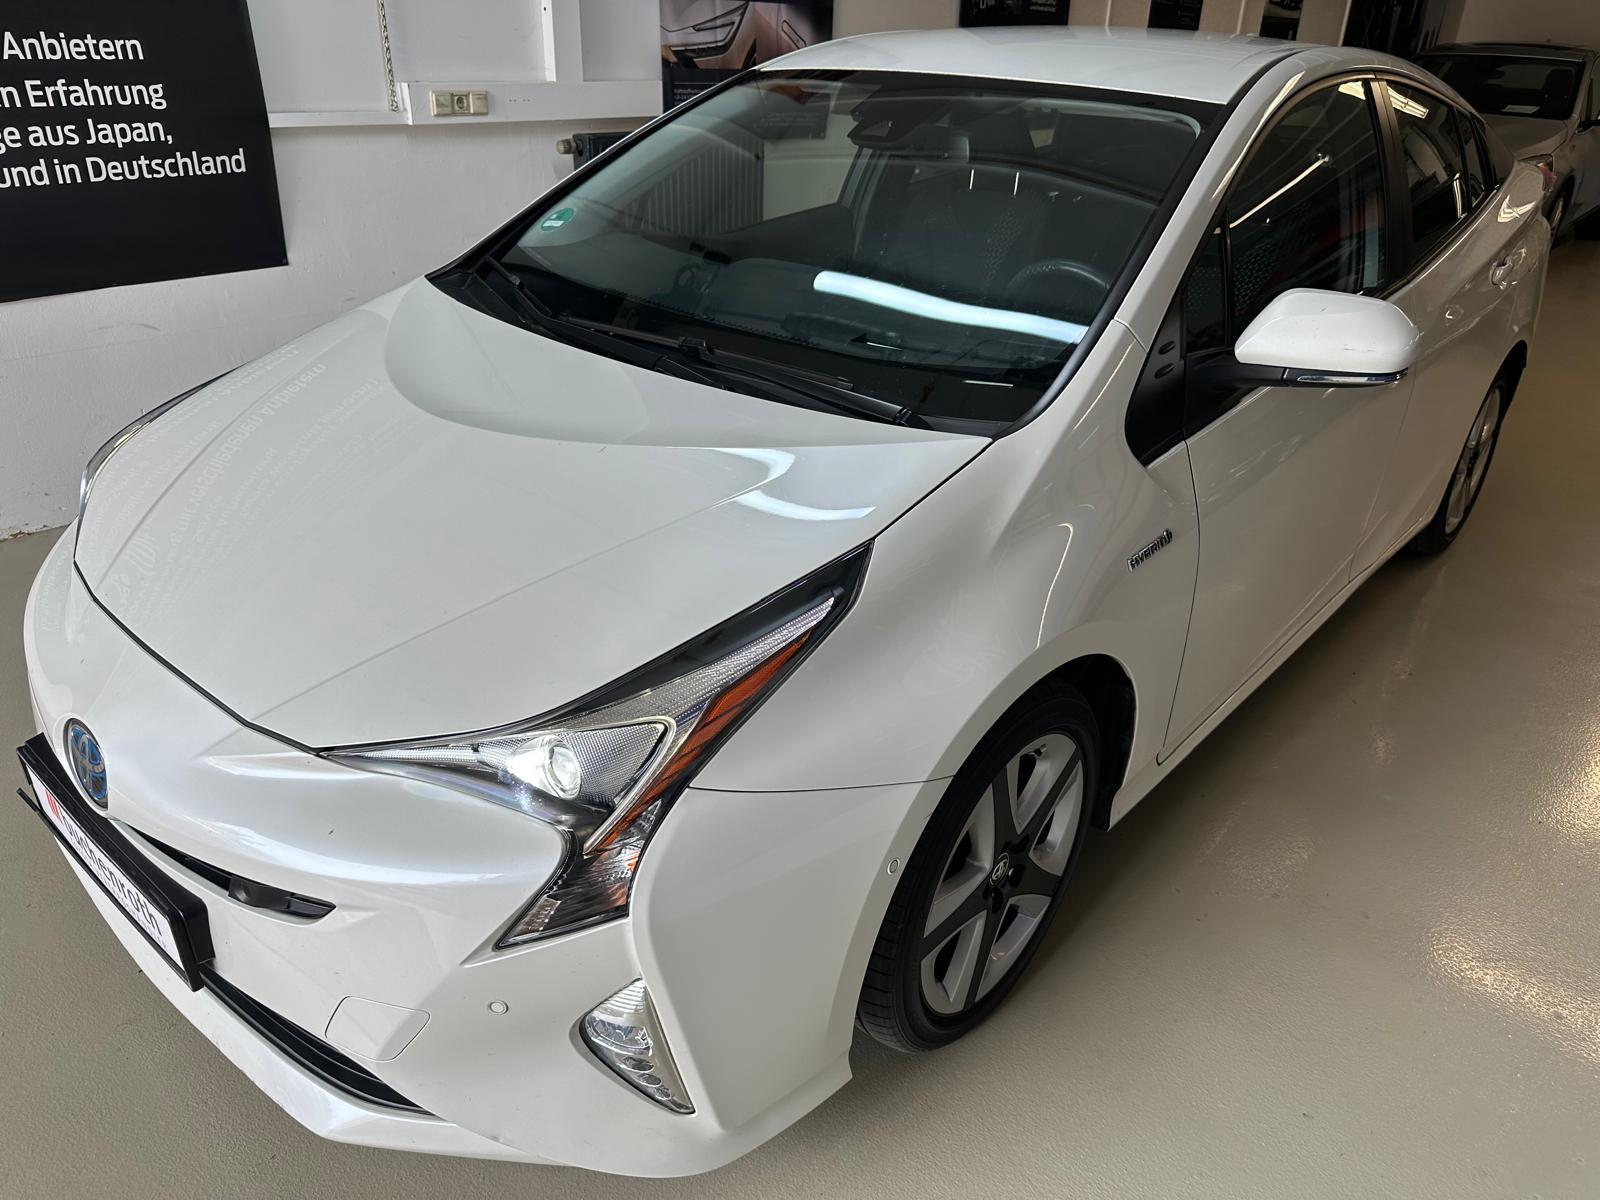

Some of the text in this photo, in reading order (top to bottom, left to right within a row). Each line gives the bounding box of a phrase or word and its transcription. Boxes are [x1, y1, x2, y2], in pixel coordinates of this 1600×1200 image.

[2, 30, 144, 61] Anbietern
[0, 78, 167, 111] n Erfahrung
[27, 124, 80, 147] aus
[85, 117, 173, 149] Japan,
[0, 147, 247, 189] und in Deutschland
